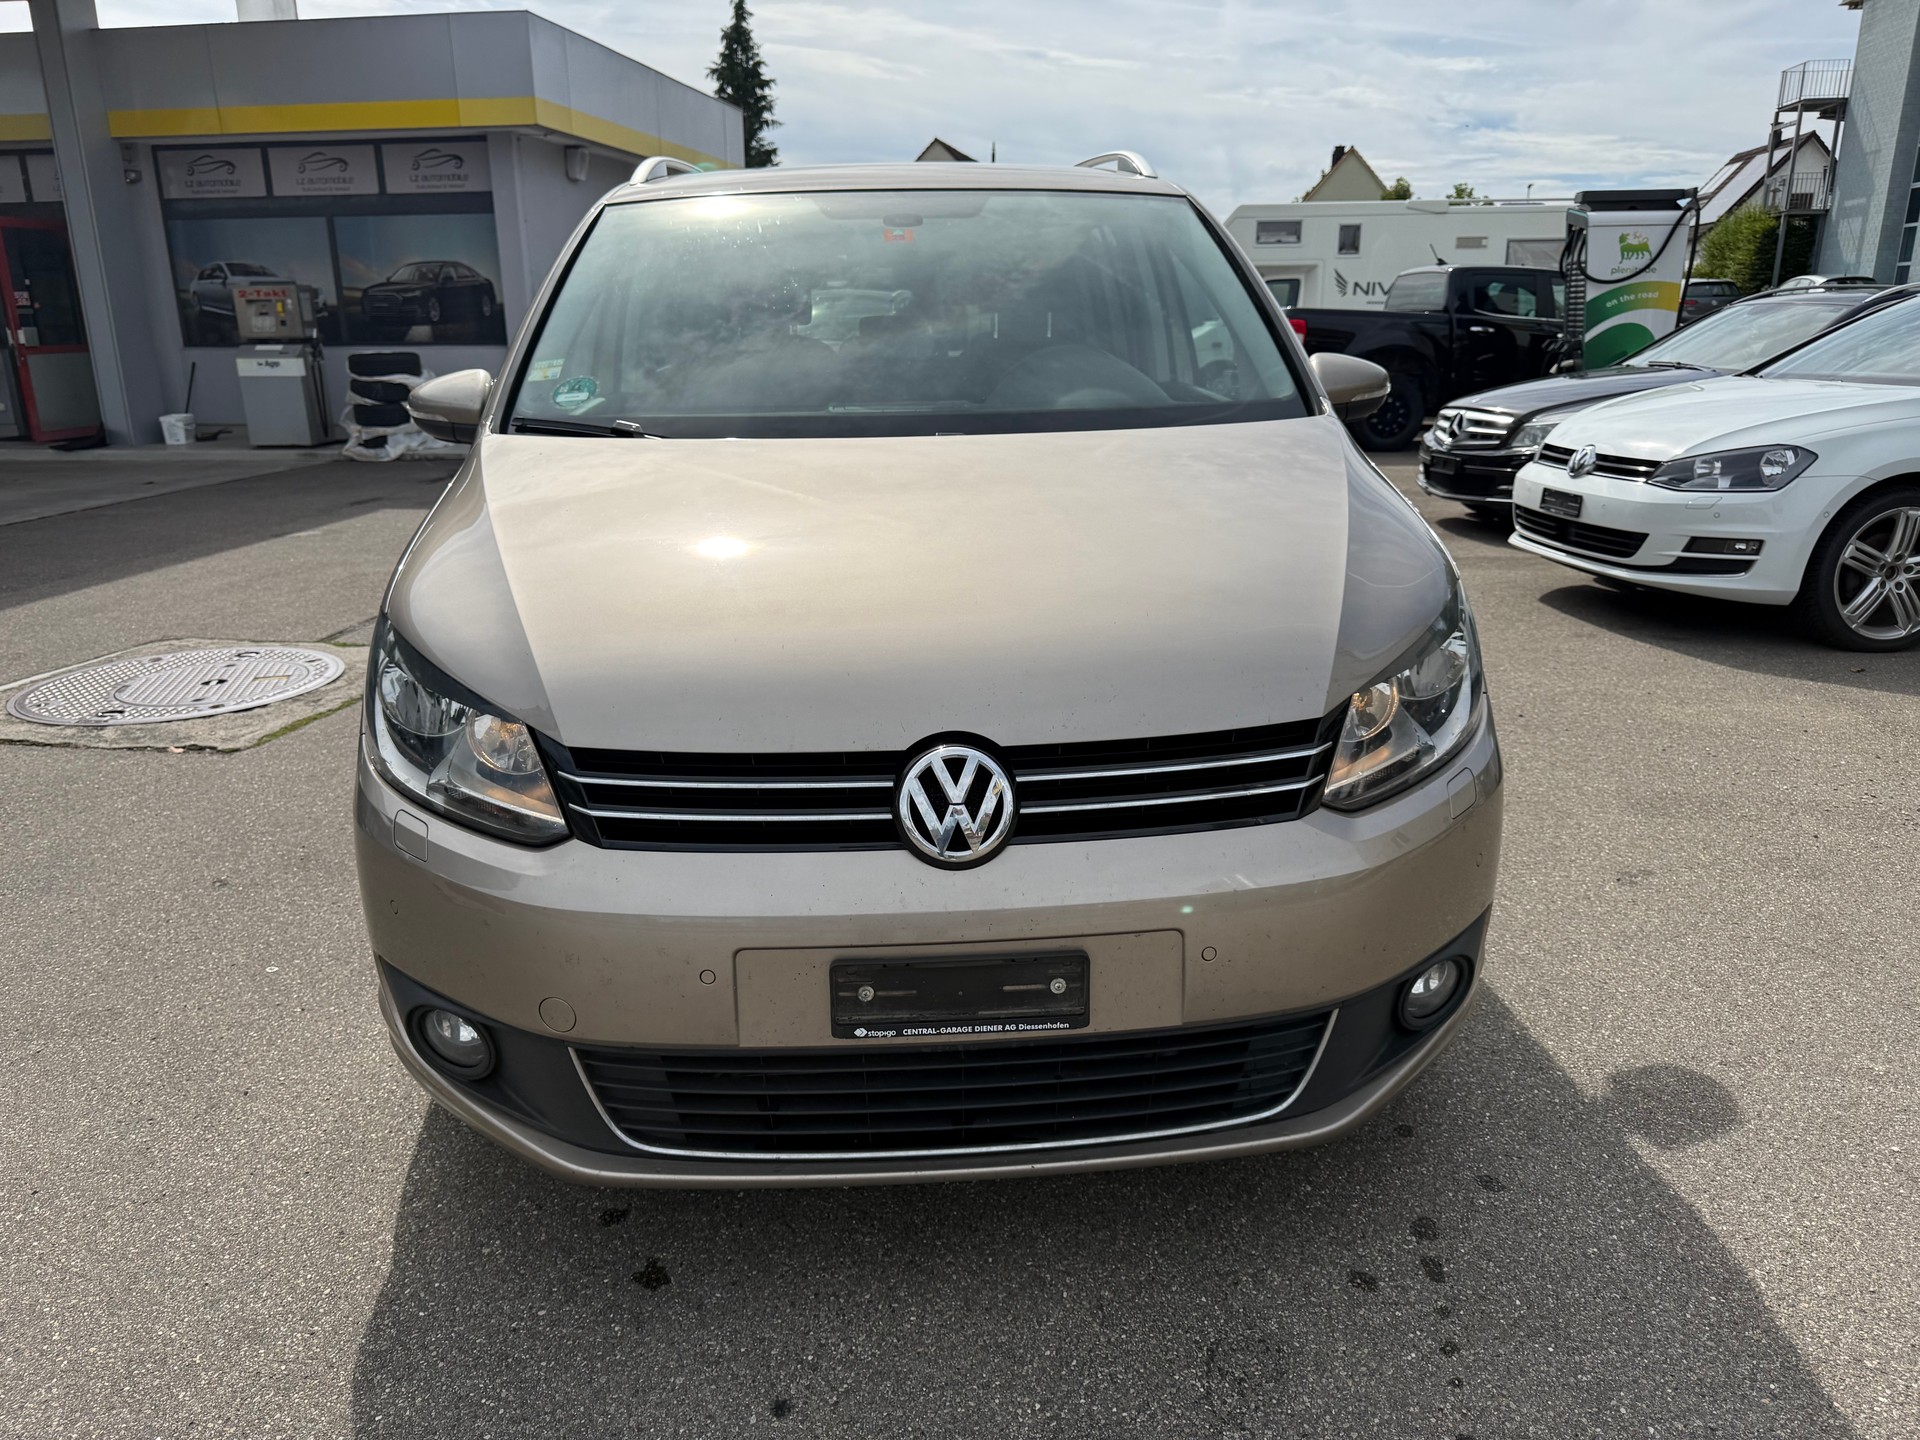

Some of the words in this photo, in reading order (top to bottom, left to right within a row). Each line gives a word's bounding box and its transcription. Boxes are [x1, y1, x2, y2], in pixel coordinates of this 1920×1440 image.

[1610, 265, 1657, 275] plenitde
[1605, 299, 1618, 308] on
[1619, 293, 1635, 303] the
[1637, 290, 1659, 299] road
[902, 1026, 973, 1036] CENTRAL-GARAGE
[974, 1024, 1003, 1033] DIENER
[1004, 1023, 1017, 1032] AG
[1018, 1021, 1070, 1031] Diessenhofen
